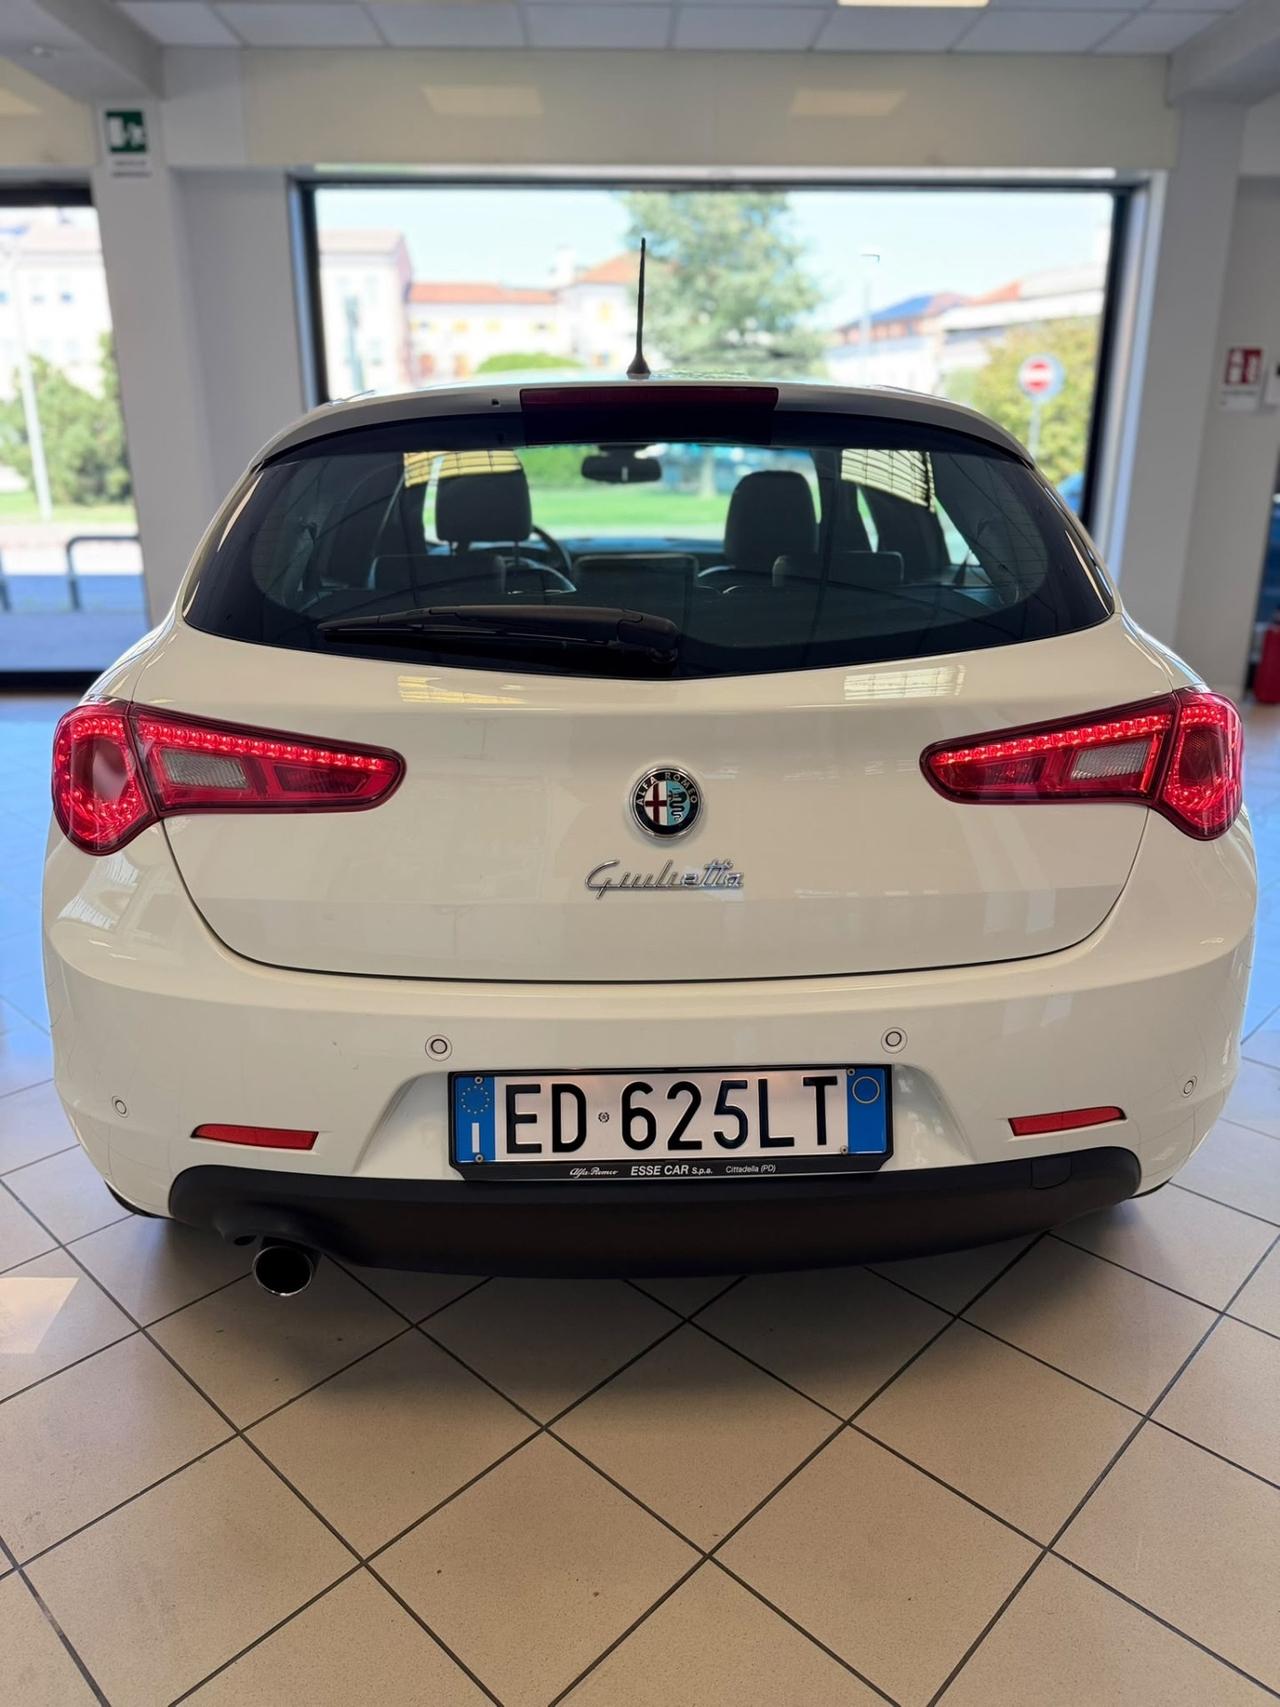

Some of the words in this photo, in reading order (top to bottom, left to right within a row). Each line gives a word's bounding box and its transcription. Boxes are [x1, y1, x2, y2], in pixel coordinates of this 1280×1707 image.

[636, 776, 657, 806] ALFA
[664, 772, 698, 804] ROMEO
[585, 859, 743, 900] Giulietta
[506, 1083, 587, 1154] ED
[621, 1076, 838, 1151] 625LT
[472, 1122, 480, 1153] I
[630, 1165, 662, 1176] ESSE
[664, 1164, 690, 1175] CAR
[691, 1166, 713, 1175] S.p.a.
[725, 1165, 759, 1174] Cittadella
[760, 1164, 776, 1174] (PD)
